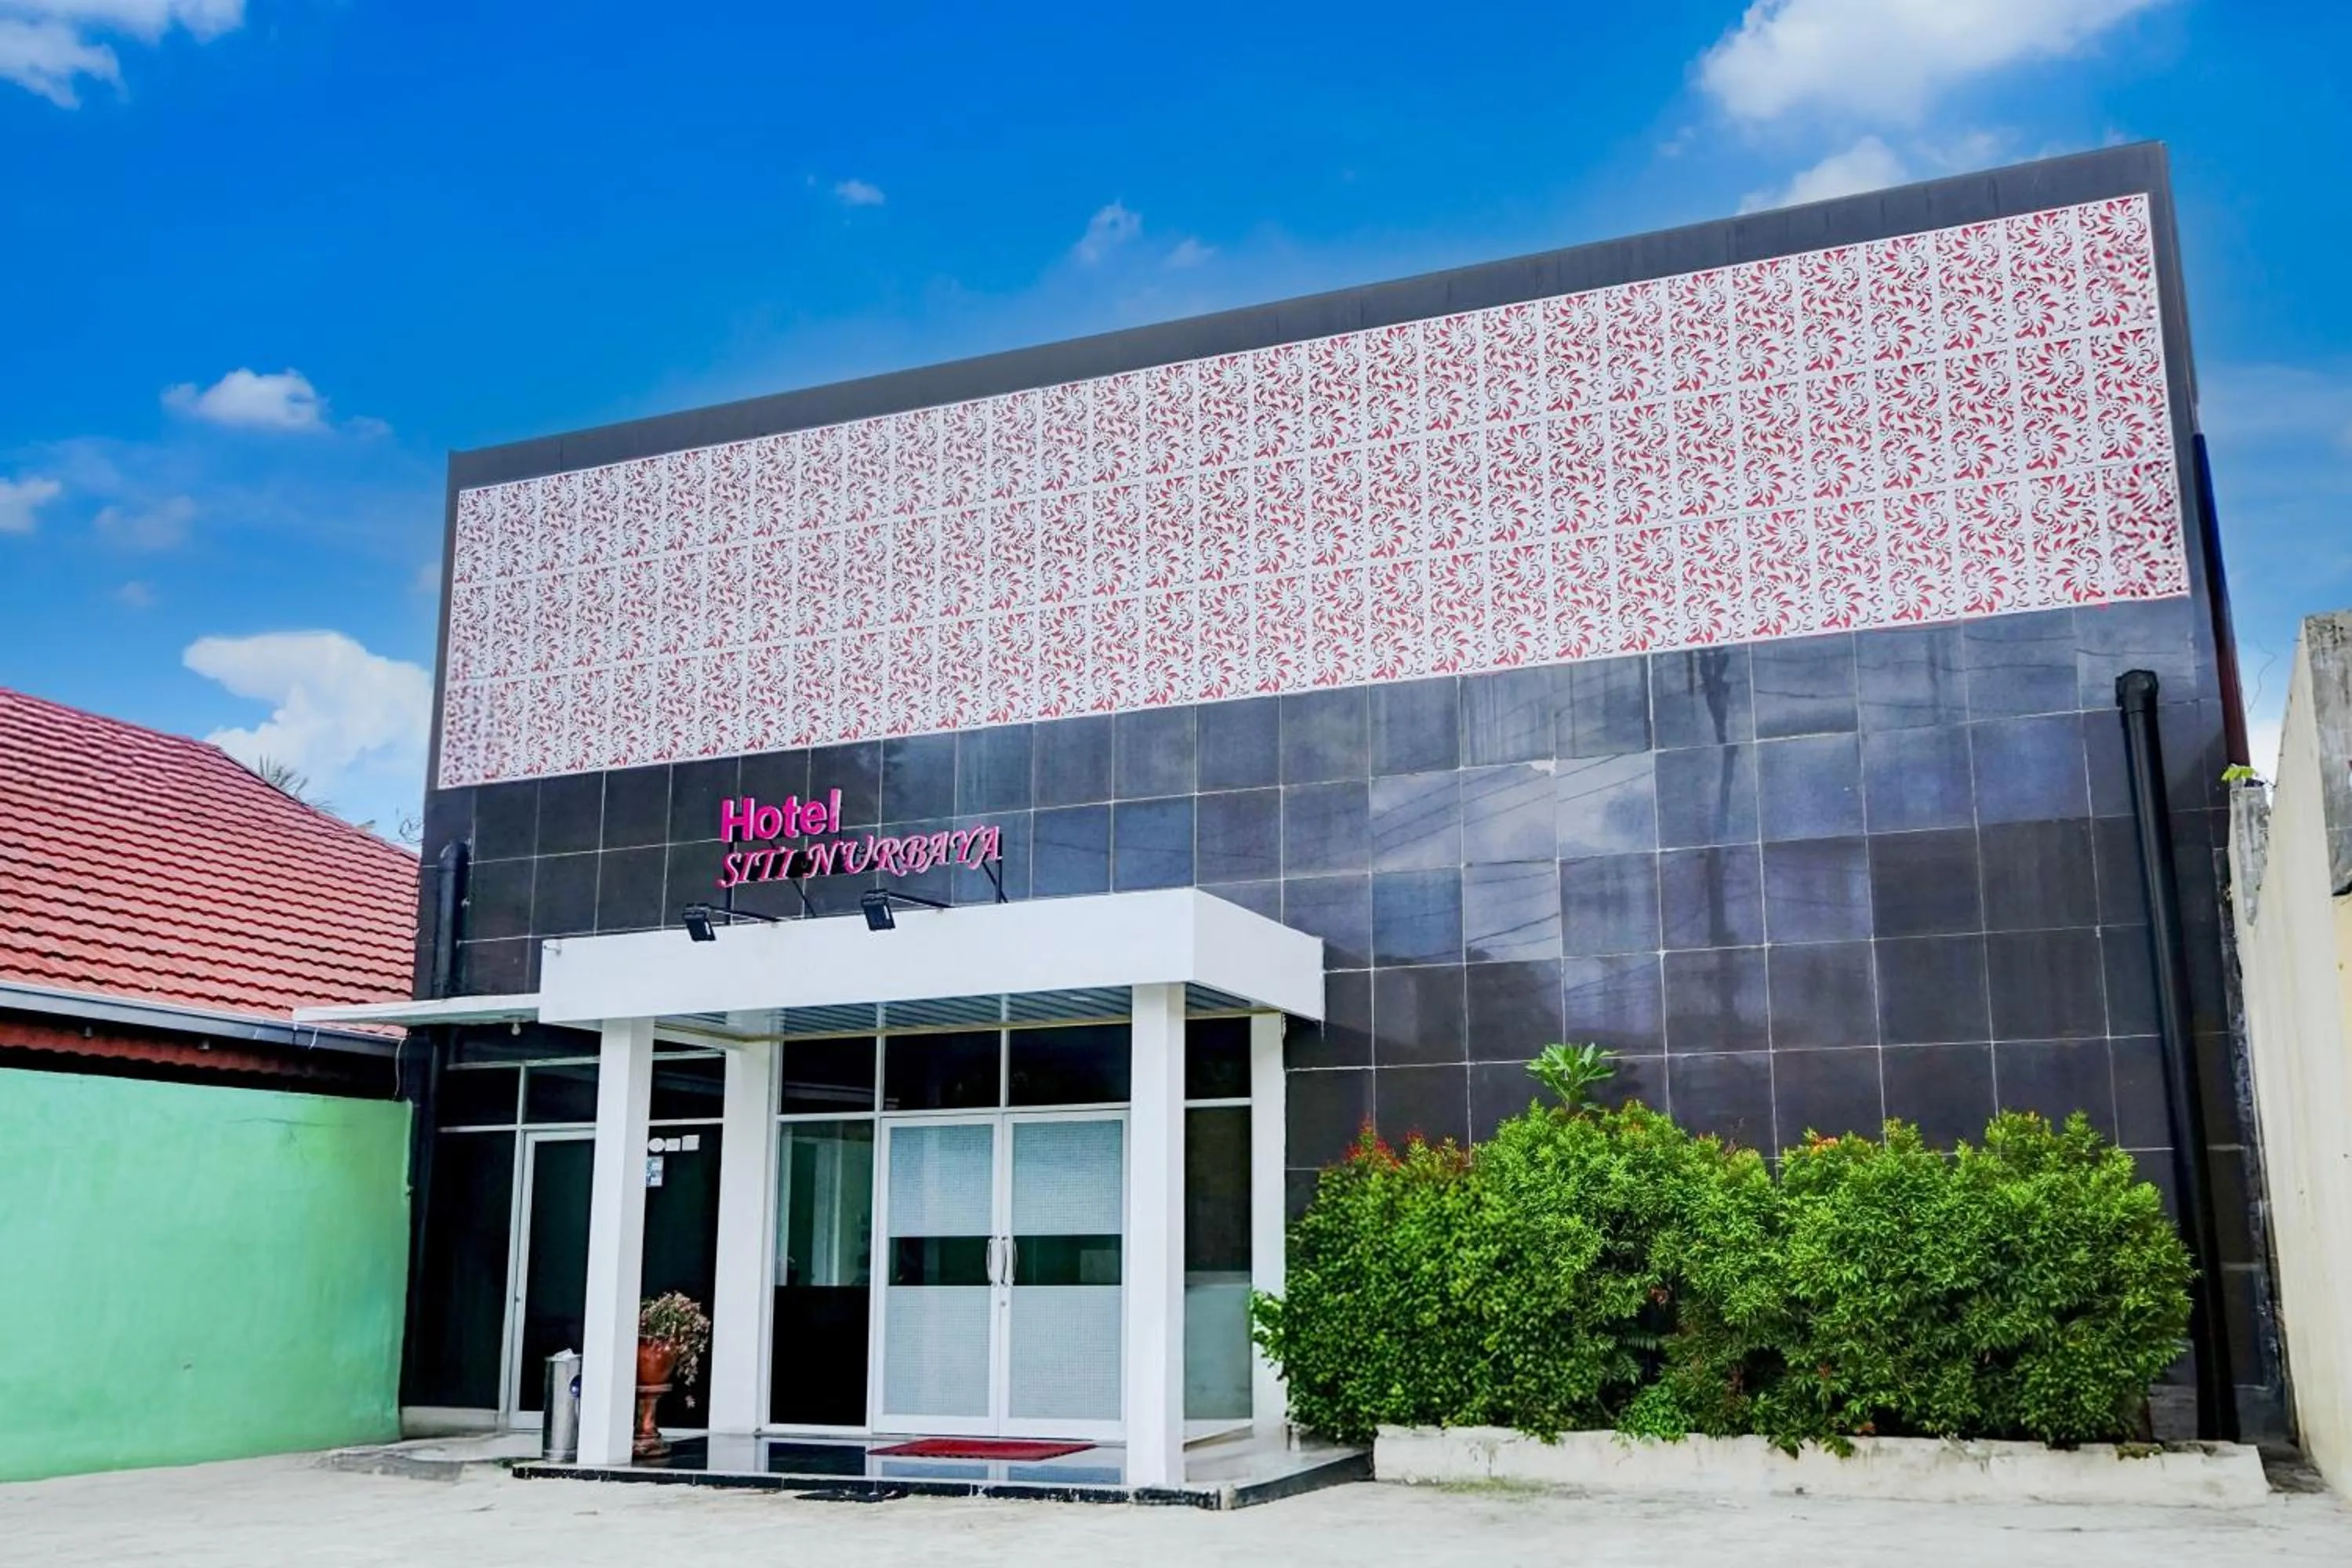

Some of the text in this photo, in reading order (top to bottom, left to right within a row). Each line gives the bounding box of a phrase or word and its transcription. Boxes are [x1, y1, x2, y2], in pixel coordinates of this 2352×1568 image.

[720, 788, 843, 843] Hotel
[718, 826, 1003, 887] SITI NURBAYA
